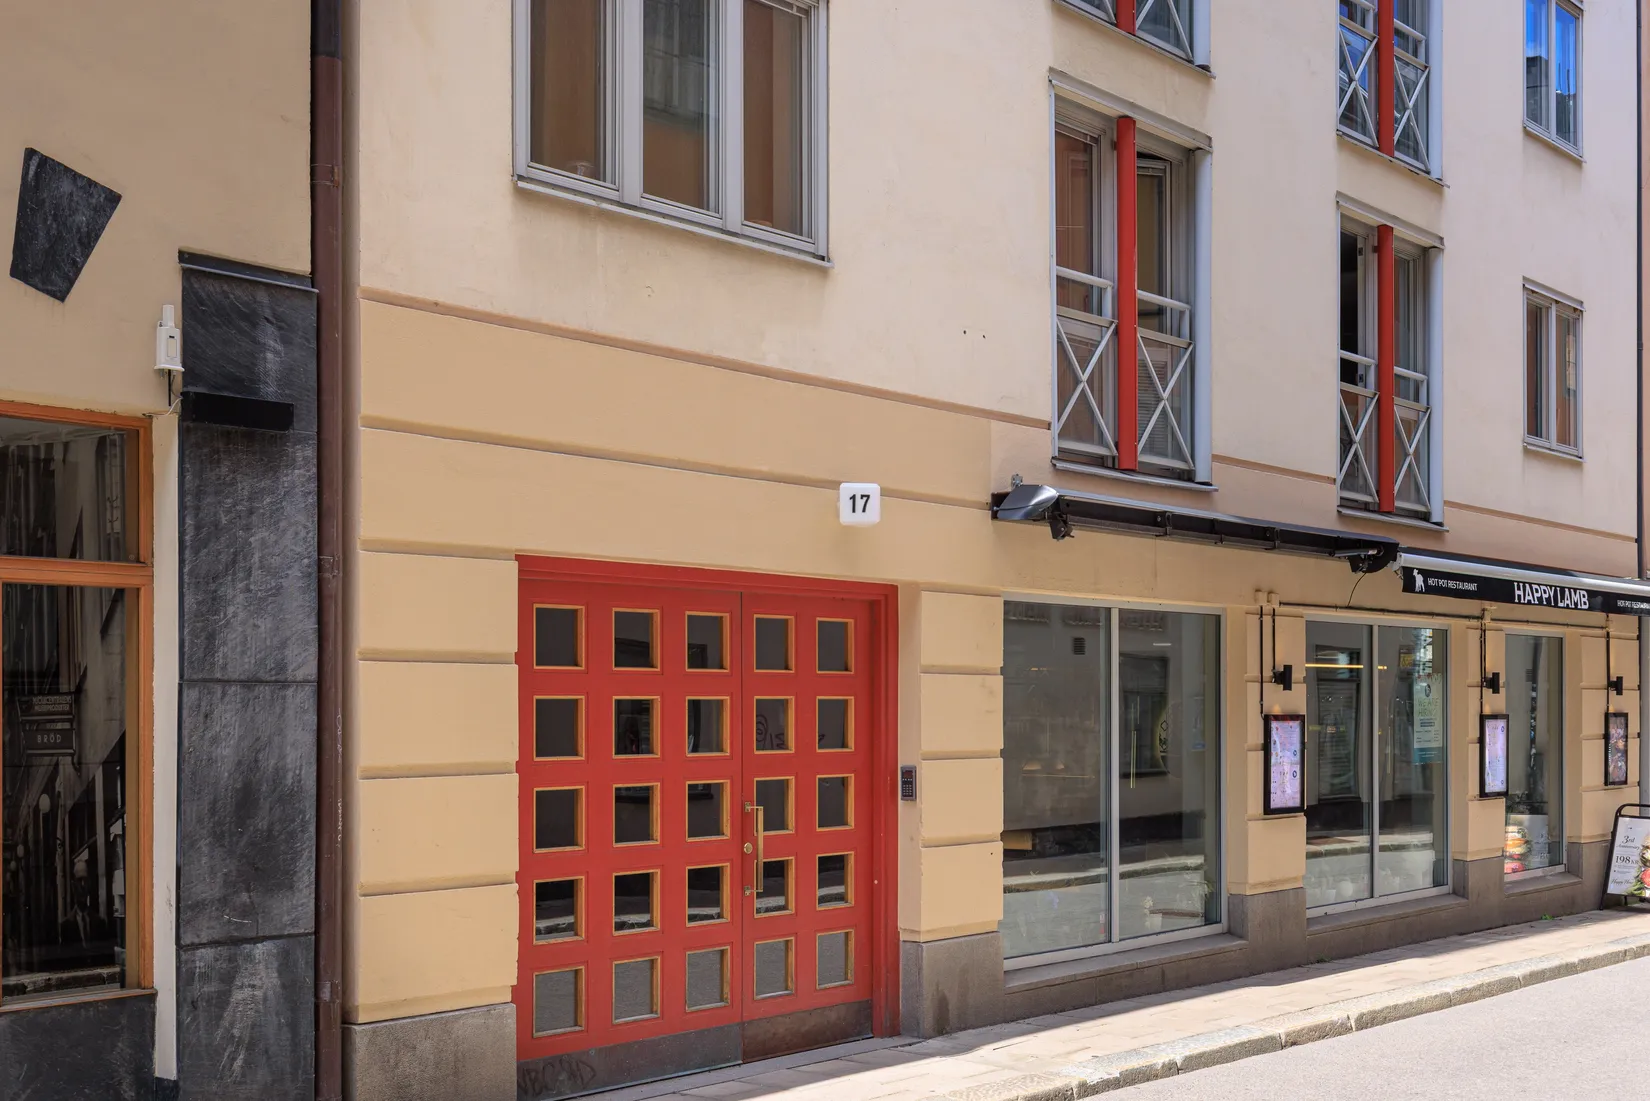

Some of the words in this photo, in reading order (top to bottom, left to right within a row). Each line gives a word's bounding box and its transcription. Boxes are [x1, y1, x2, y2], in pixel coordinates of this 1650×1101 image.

[849, 493, 871, 514] 17
[1427, 577, 1439, 587] HOT
[1438, 579, 1448, 588] POT
[1447, 580, 1478, 591] RESTAURANT
[1513, 581, 1556, 606] HAPPY
[1556, 587, 1590, 610] LAMB
[37, 732, 62, 743] BRÖD
[1621, 835, 1636, 844] 3rd
[1615, 855, 1631, 864] 198
